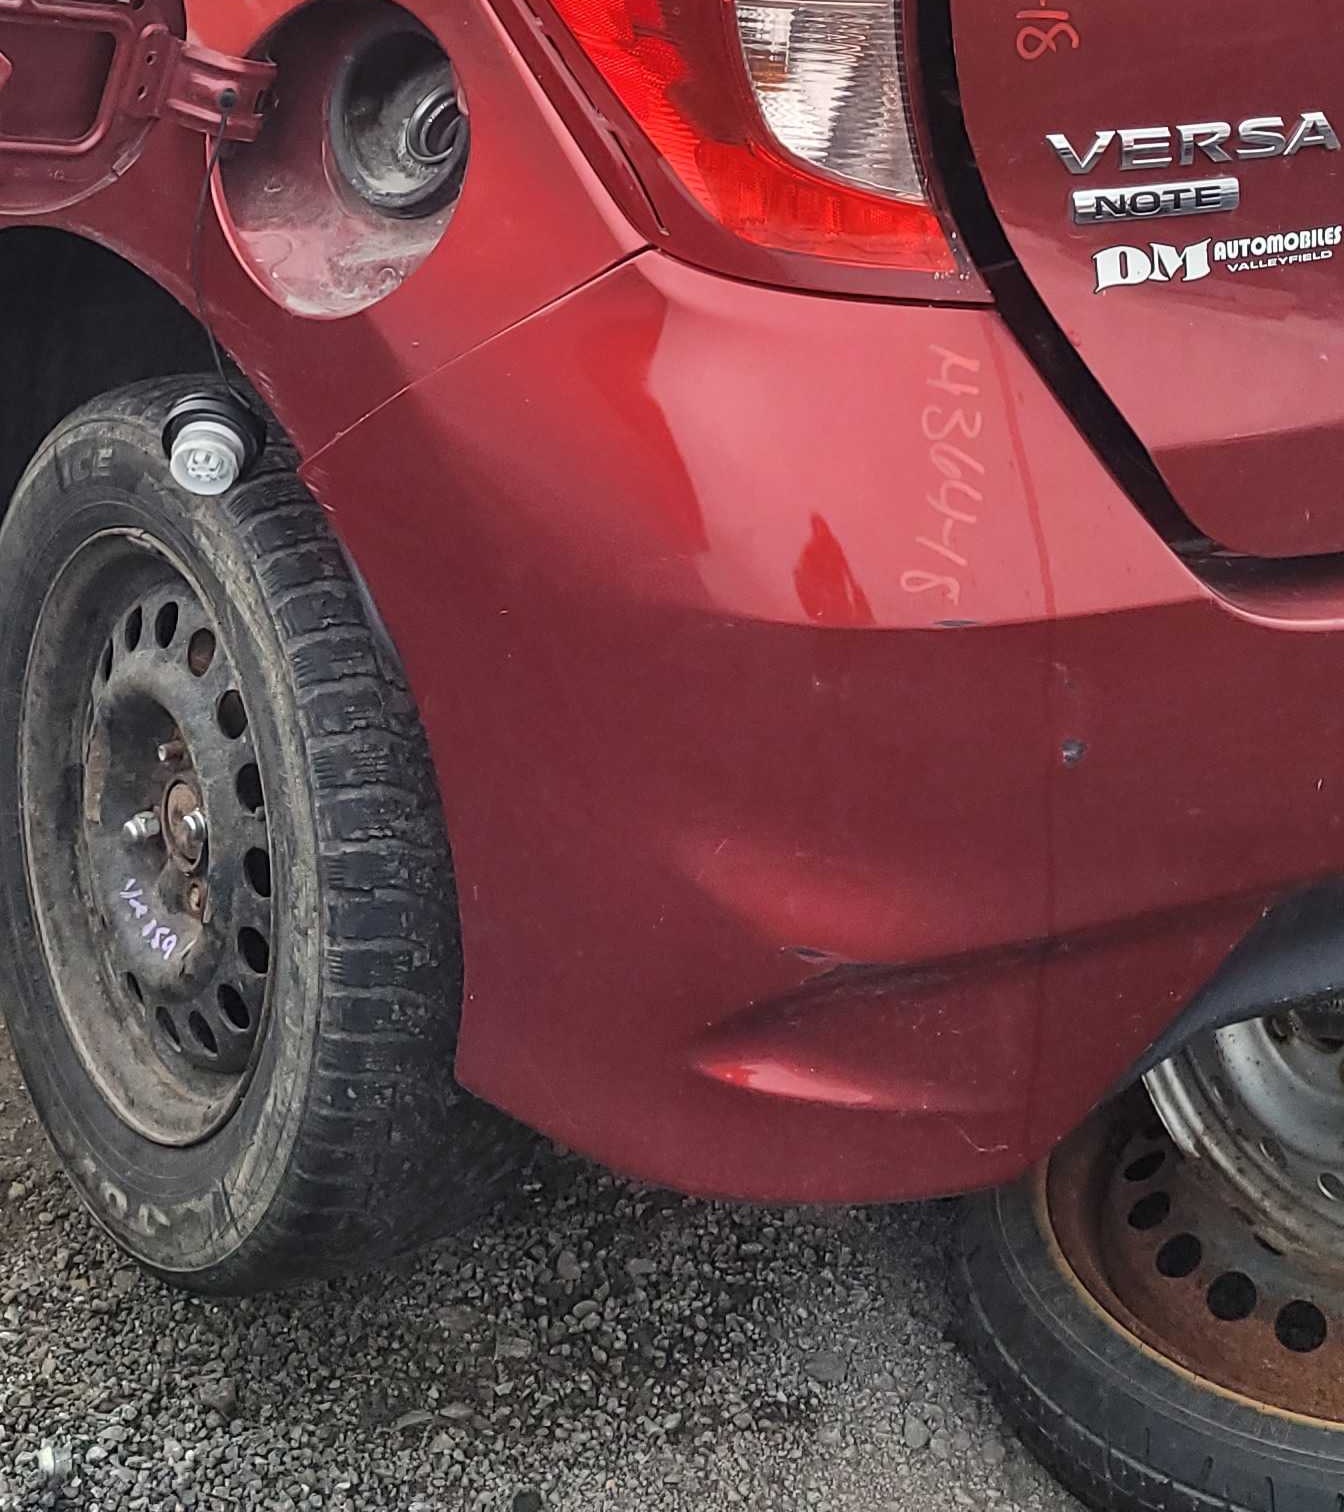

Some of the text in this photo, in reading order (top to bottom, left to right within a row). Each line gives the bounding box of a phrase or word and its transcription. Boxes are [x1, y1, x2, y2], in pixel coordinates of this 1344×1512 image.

[1046, 111, 1343, 175] VERSA
[1094, 185, 1223, 219] NOTE
[1092, 224, 1344, 294] DM AUTOMOBILES
[1226, 249, 1334, 273] VALLEYFIELD
